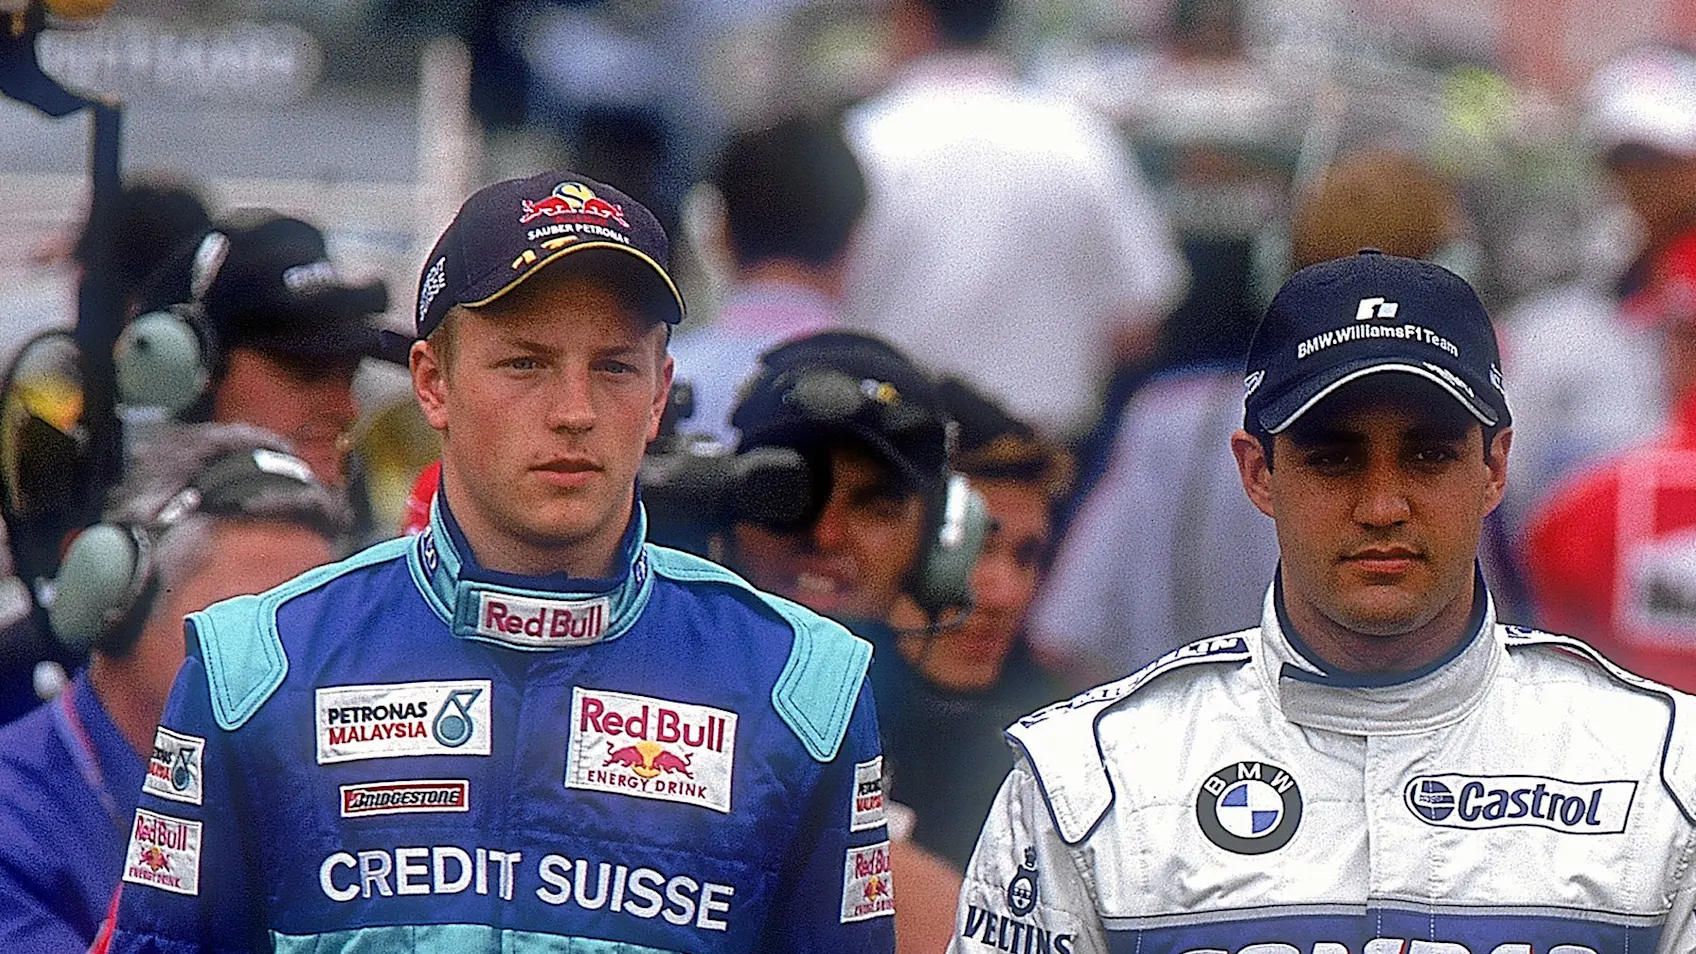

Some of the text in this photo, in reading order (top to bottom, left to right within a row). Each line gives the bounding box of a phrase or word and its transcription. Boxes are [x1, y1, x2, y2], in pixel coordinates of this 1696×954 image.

[527, 224, 575, 241] SAUBER
[486, 601, 602, 638] Red Bull
[328, 701, 428, 725] PETRONAS
[579, 696, 725, 753] Red Bull
[329, 721, 428, 746] MALAYSIA
[587, 770, 708, 800] ENERGY DRINK
[1203, 762, 1294, 797] BMW
[350, 789, 460, 809] BRIDGESTONE
[1457, 780, 1603, 827] Castrol
[135, 815, 188, 852] Red Bull
[319, 846, 735, 932] CREDIT SUISSE
